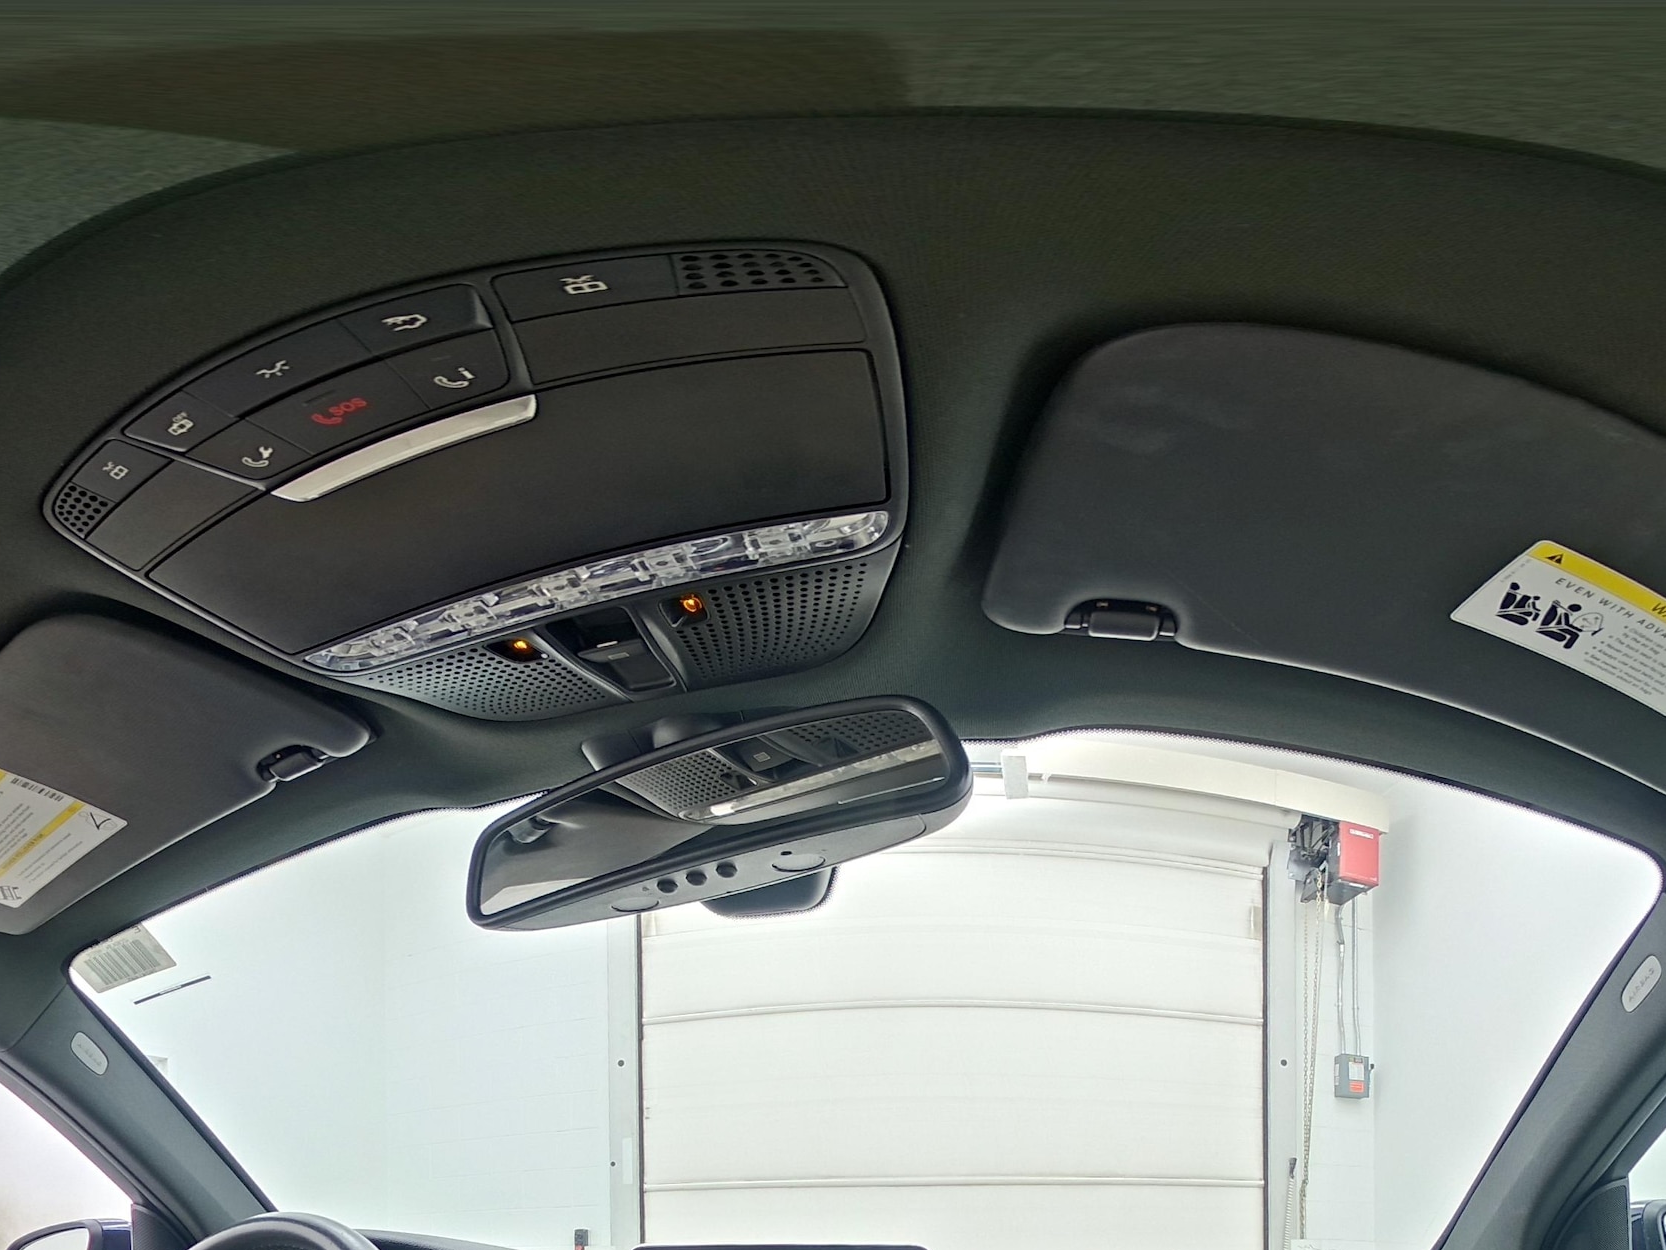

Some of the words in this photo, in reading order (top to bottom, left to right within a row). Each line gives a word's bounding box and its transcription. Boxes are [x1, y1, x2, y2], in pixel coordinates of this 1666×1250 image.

[328, 397, 367, 416] SOS
[1555, 577, 1595, 599] EVEN
[1599, 597, 1635, 618] WITH
